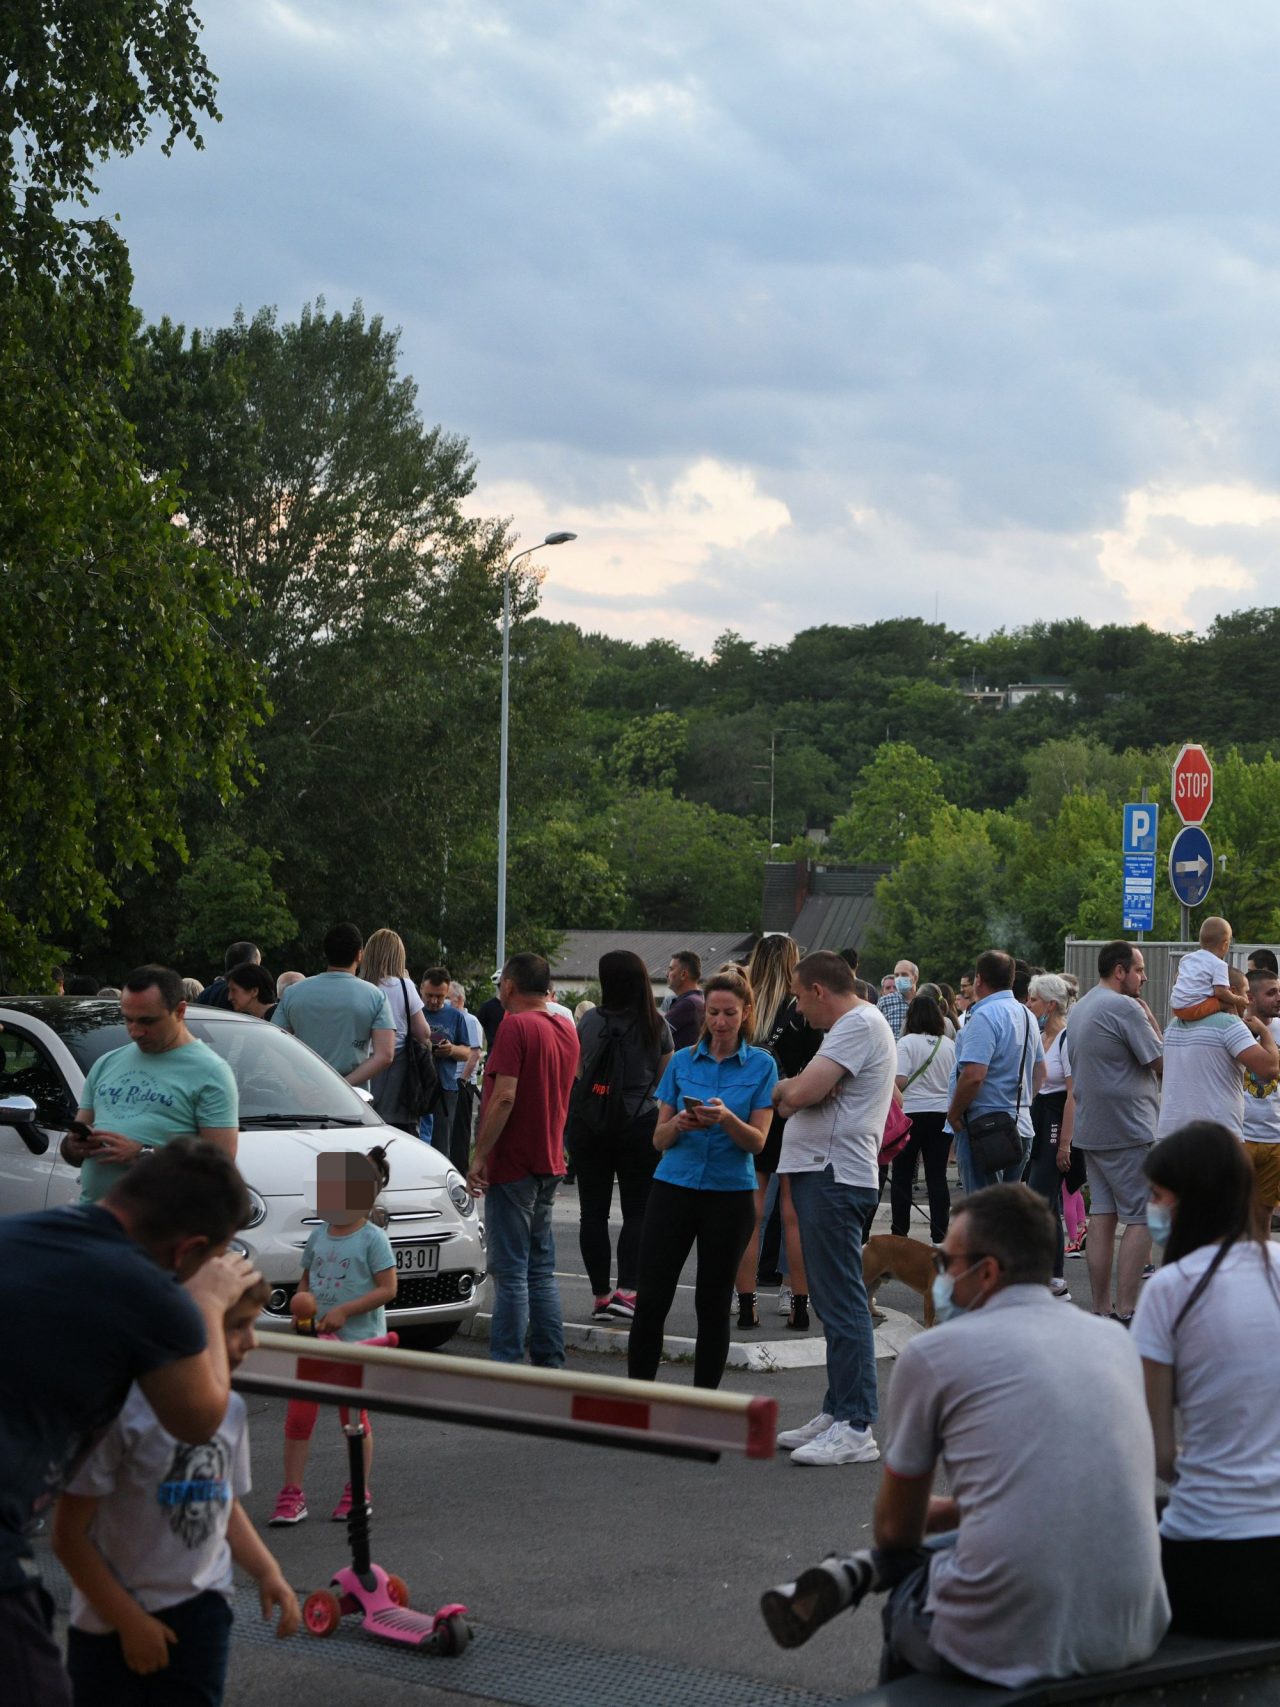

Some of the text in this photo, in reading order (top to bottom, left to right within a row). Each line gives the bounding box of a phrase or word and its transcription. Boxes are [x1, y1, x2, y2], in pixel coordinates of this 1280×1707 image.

[1178, 772, 1208, 799] STOP
[1132, 810, 1149, 846] P
[125, 1086, 173, 1107] Riders
